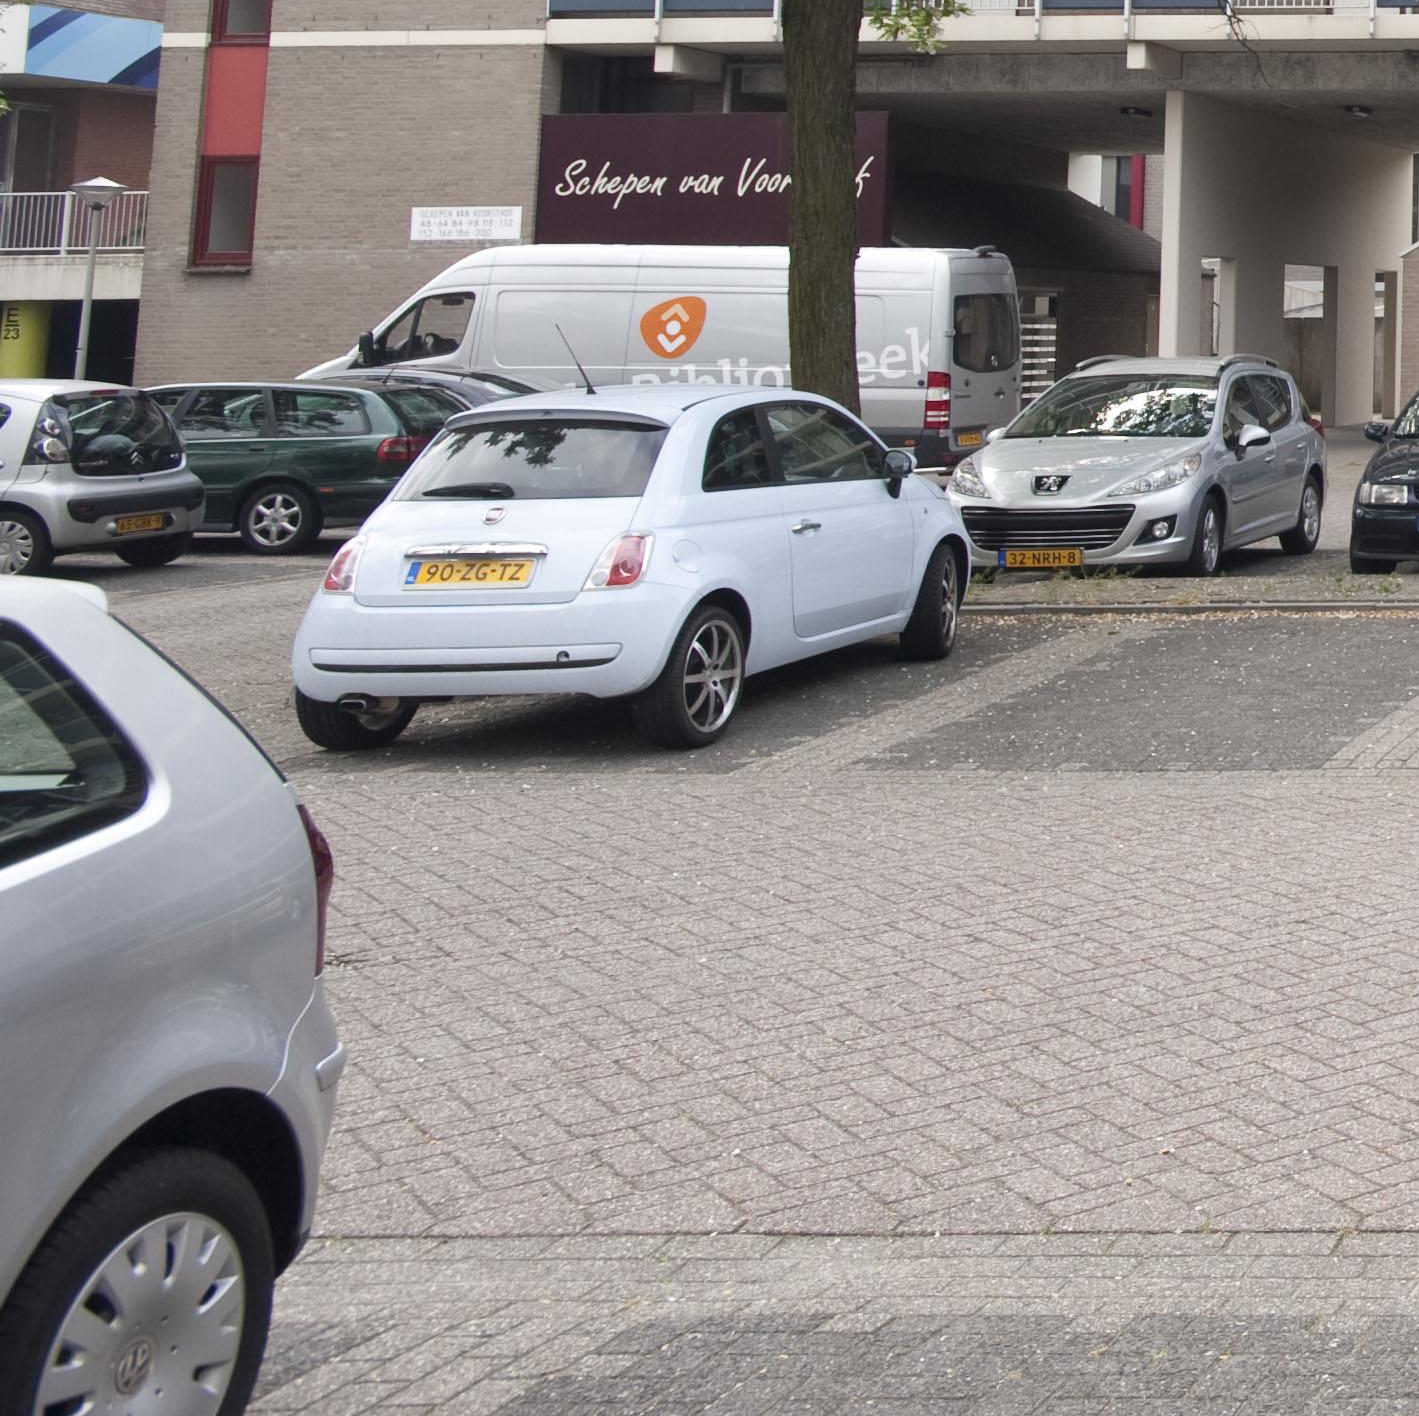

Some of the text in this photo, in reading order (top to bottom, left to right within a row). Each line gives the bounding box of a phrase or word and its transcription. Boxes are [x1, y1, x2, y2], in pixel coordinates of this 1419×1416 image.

[555, 158, 667, 209] Schepen
[679, 173, 724, 195] van
[456, 209, 470, 217] VAN
[3, 327, 20, 340] 23
[1009, 551, 1076, 565] 32-NRH-8
[425, 563, 525, 582] 90-ZG-TZ
